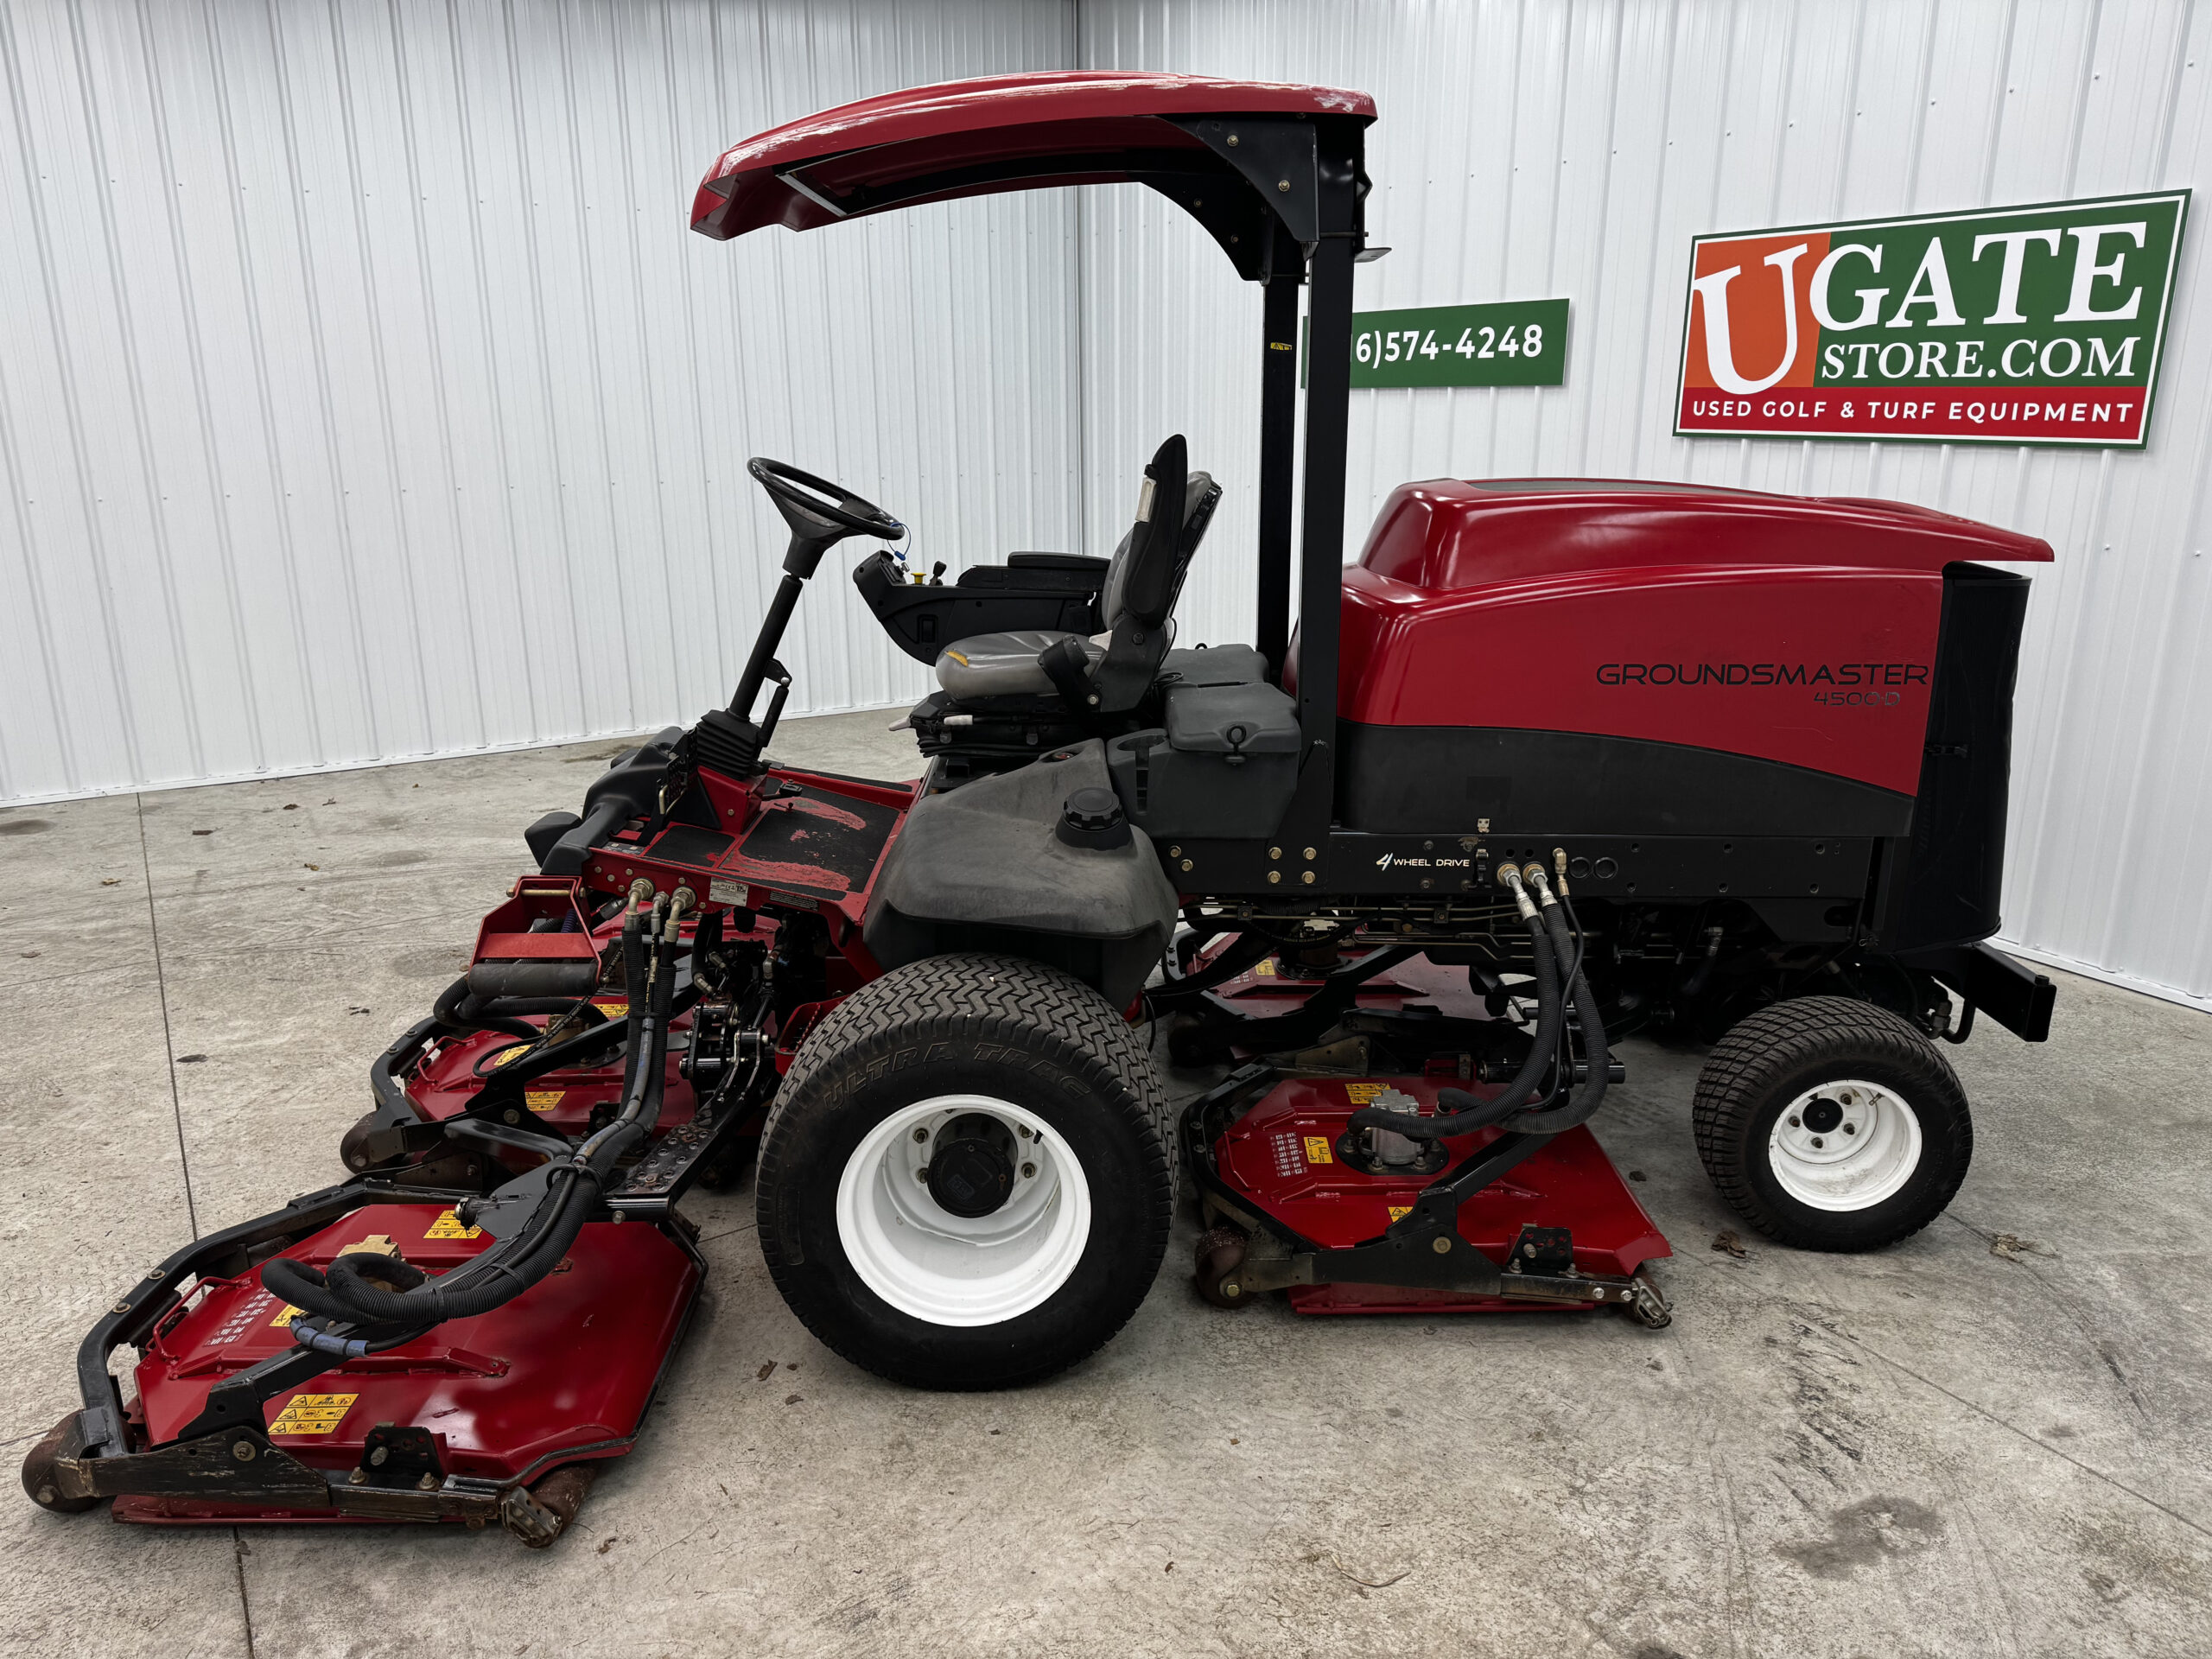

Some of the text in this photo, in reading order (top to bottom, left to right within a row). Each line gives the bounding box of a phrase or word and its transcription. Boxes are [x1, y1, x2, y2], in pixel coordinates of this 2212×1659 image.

[1353, 324, 1542, 369] 6)574-4248
[1821, 337, 2140, 378] STORE.COM
[1693, 400, 2133, 422] USED GOLF & TURF EQUIPMENT
[1596, 664, 1929, 685] GROUNDSMASTER
[1376, 853, 1393, 871] 4
[1436, 859, 1470, 868] DRIVE
[823, 1041, 1092, 1111] ULTRA TRAC
